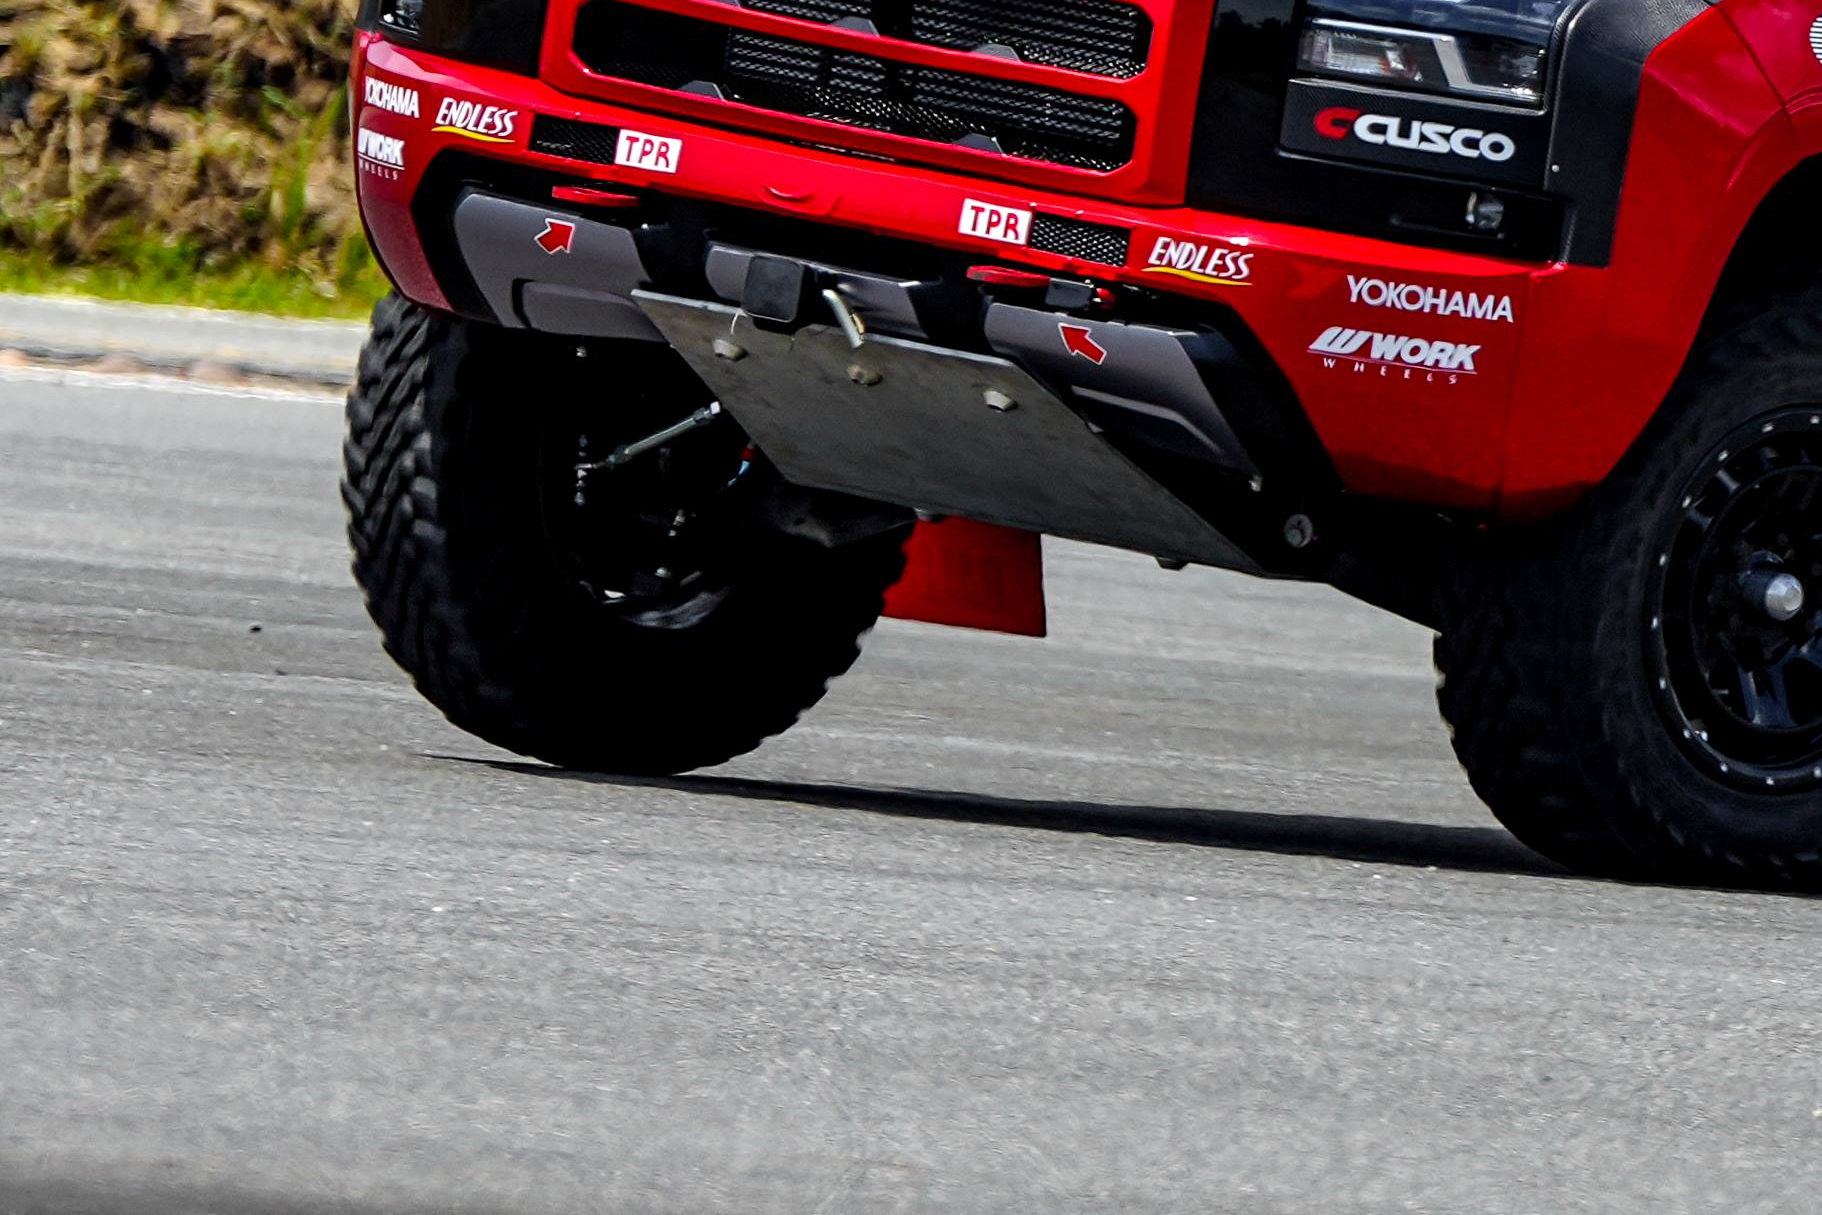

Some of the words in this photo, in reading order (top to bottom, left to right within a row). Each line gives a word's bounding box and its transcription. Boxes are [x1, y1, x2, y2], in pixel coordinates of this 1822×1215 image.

[435, 97, 518, 137] ENDLESS
[624, 139, 671, 169] TPR
[1353, 113, 1516, 162] CUSCO
[967, 205, 1020, 241] TPR
[1150, 237, 1254, 280] ENDLESS
[1346, 274, 1515, 323] YOKOHAMA
[1370, 332, 1483, 371] WORK
